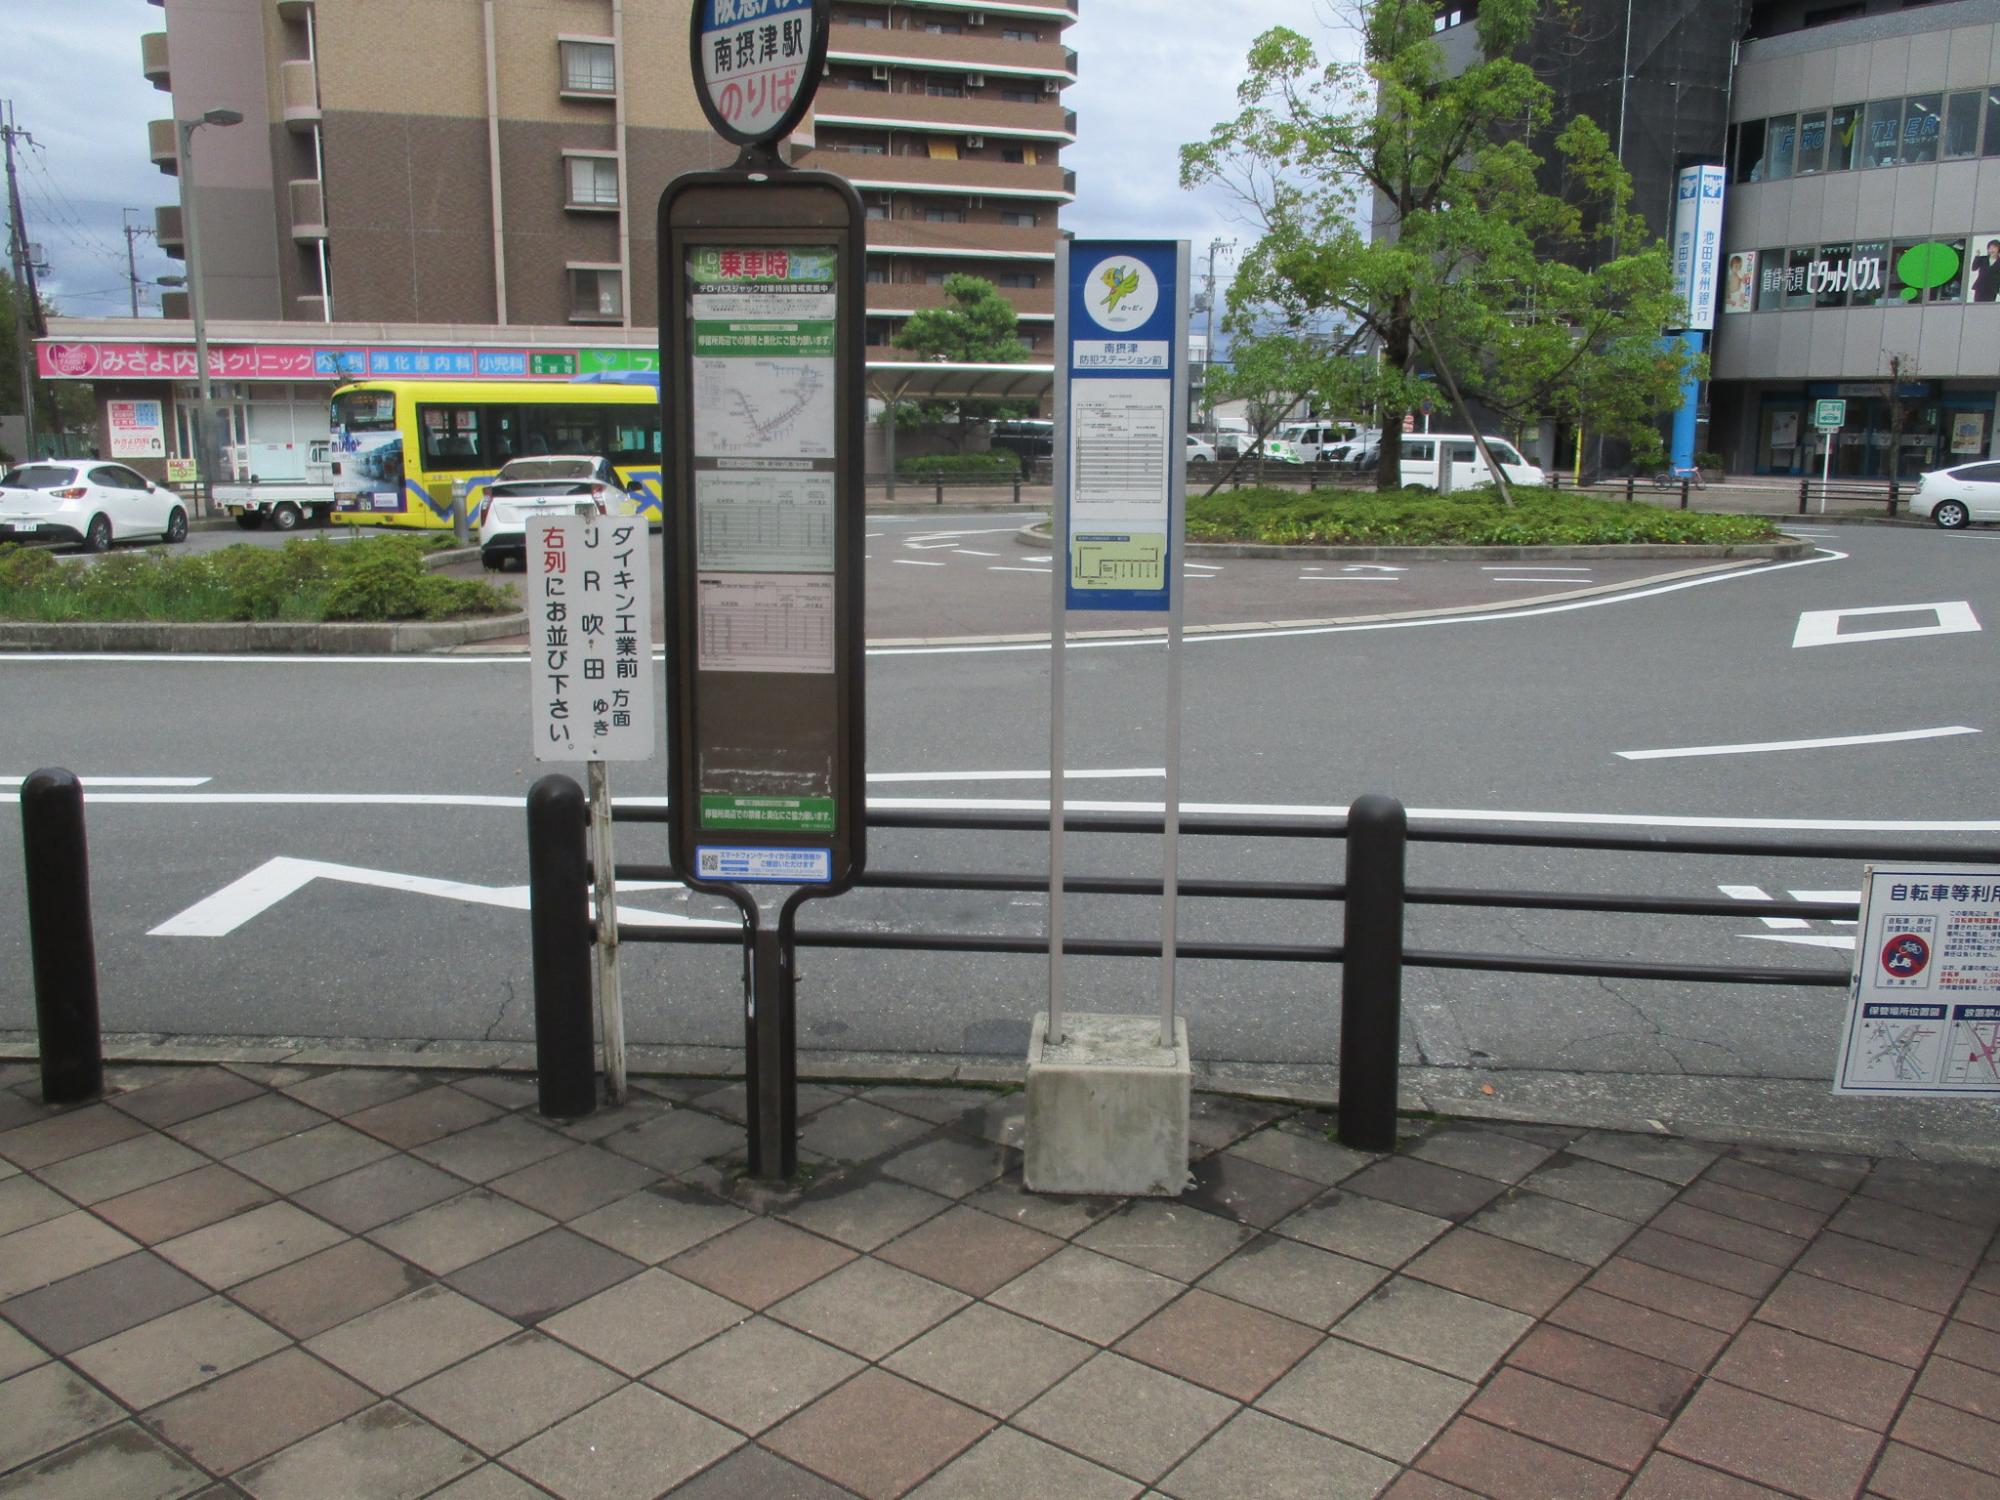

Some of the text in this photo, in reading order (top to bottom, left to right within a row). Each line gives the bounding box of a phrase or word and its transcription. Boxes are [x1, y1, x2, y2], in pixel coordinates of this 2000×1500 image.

[714, 18, 803, 73] 南摂津駅
[719, 69, 796, 120] のりば
[719, 250, 788, 279] 乗車時
[1697, 230, 1714, 321] 池田泉州銀行
[1806, 257, 1880, 294] ピタットハウス
[479, 356, 524, 371] 小児科
[1079, 354, 1162, 366] 防犯ステーション前
[1104, 343, 1138, 354] 南摂津
[543, 526, 575, 750] 右列にお並び下さい。
[582, 527, 609, 736] JR吹田 ゆき
[611, 526, 637, 727] ダイキン工業前 方面
